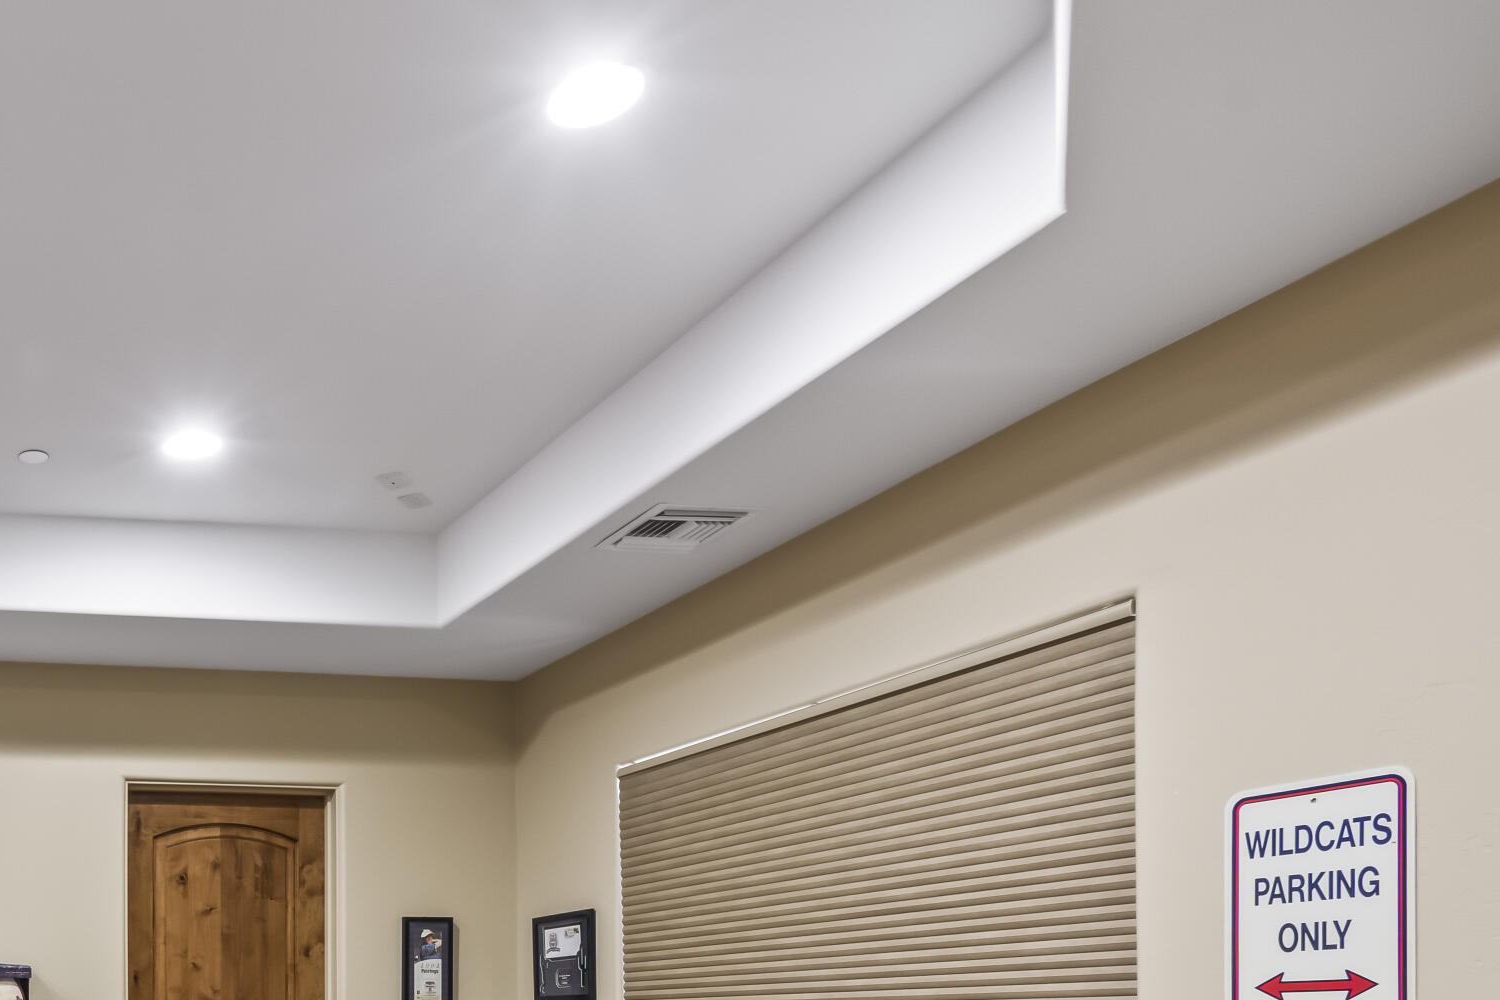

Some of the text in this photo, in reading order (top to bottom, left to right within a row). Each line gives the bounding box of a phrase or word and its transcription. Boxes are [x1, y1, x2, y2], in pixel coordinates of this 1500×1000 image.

[1245, 813, 1392, 859] WILDCATS
[1254, 866, 1380, 906] PARKING
[1278, 919, 1352, 953] ONLY
